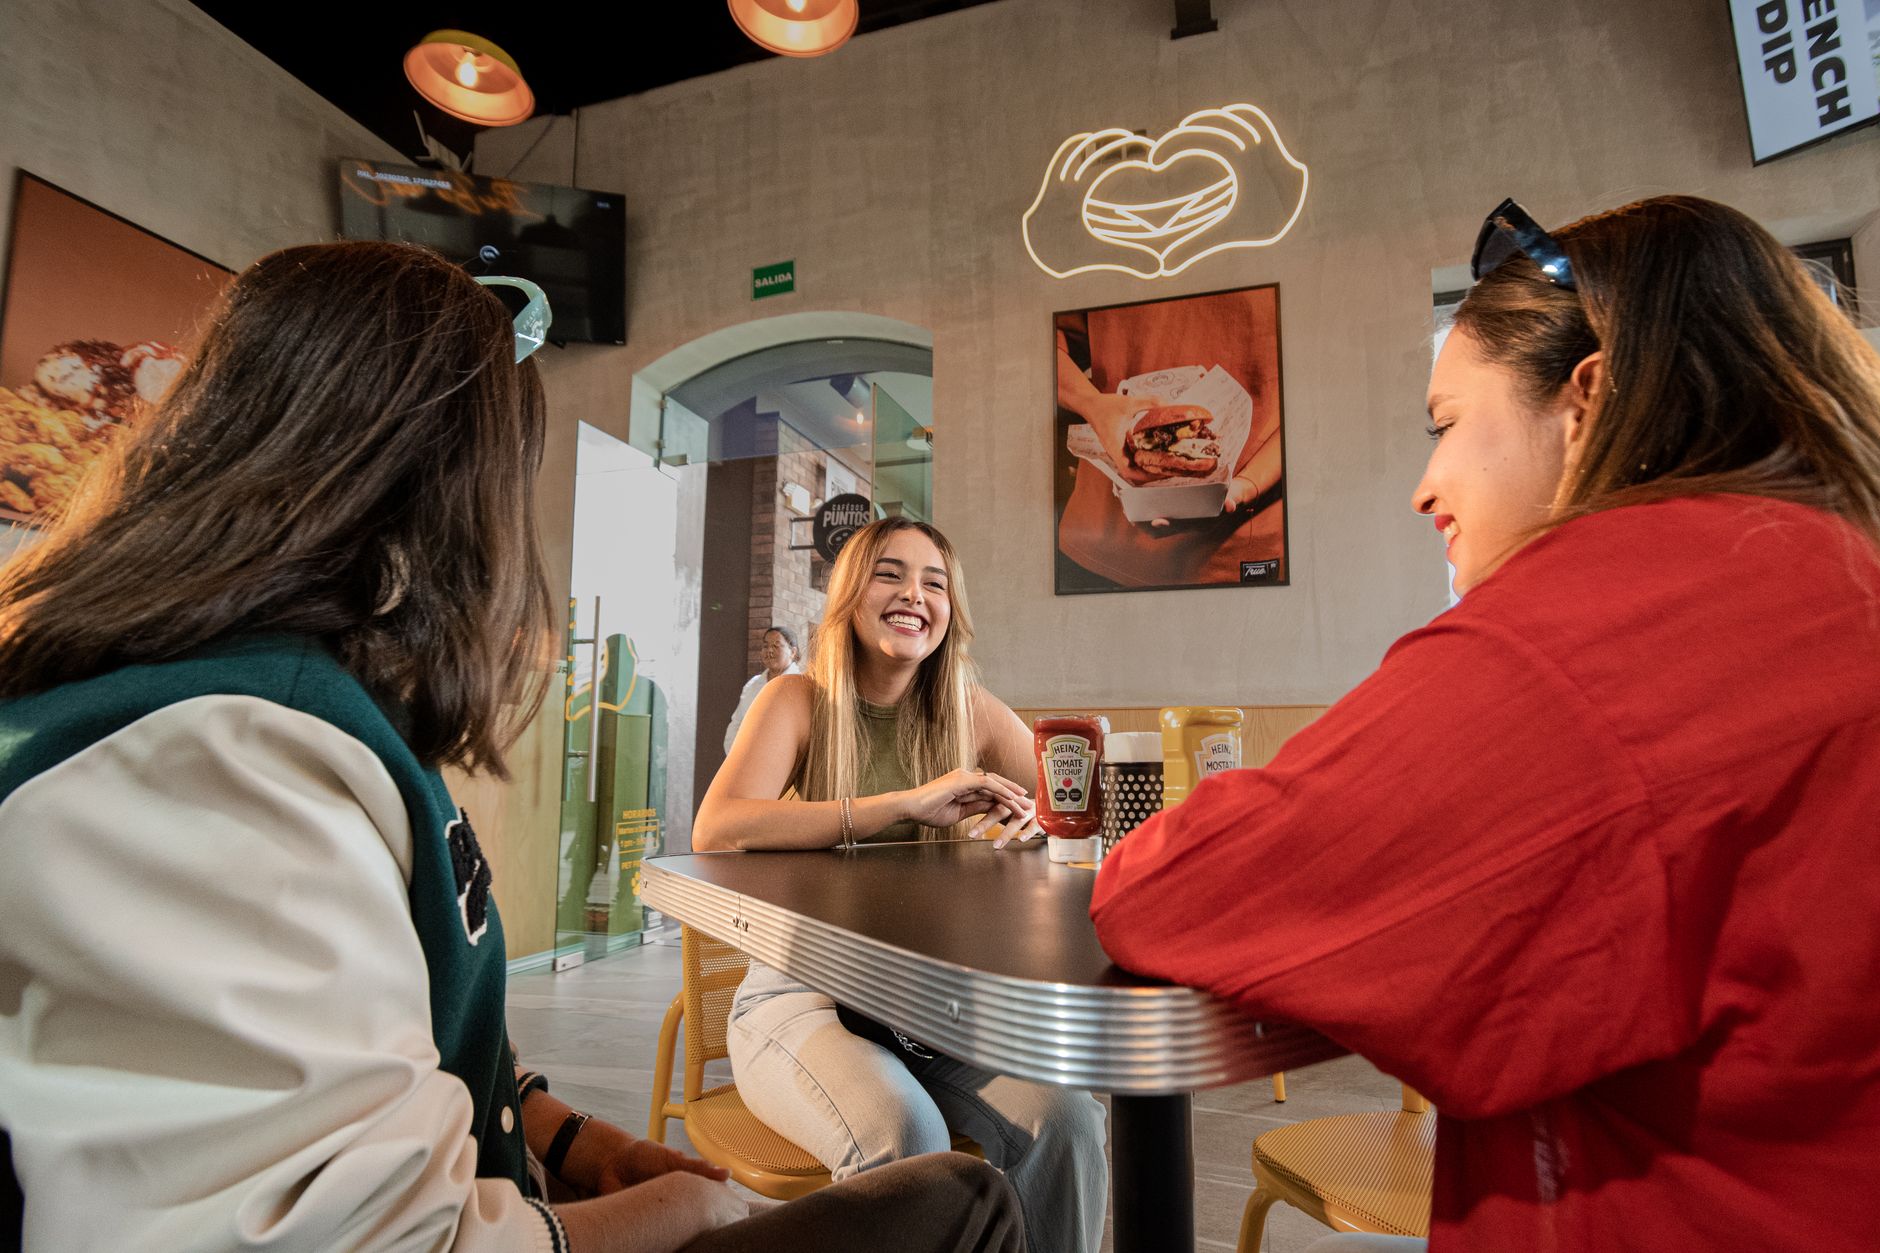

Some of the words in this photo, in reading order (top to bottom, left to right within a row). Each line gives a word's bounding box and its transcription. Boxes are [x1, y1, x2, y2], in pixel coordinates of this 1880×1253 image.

[1756, 0, 1797, 84] DIP
[755, 272, 792, 288] SALIDA
[823, 511, 870, 527] PUNTOS
[1054, 744, 1080, 754] HEINZ
[1052, 759, 1083, 768] TOMATE
[1053, 768, 1082, 776] KETCHUP
